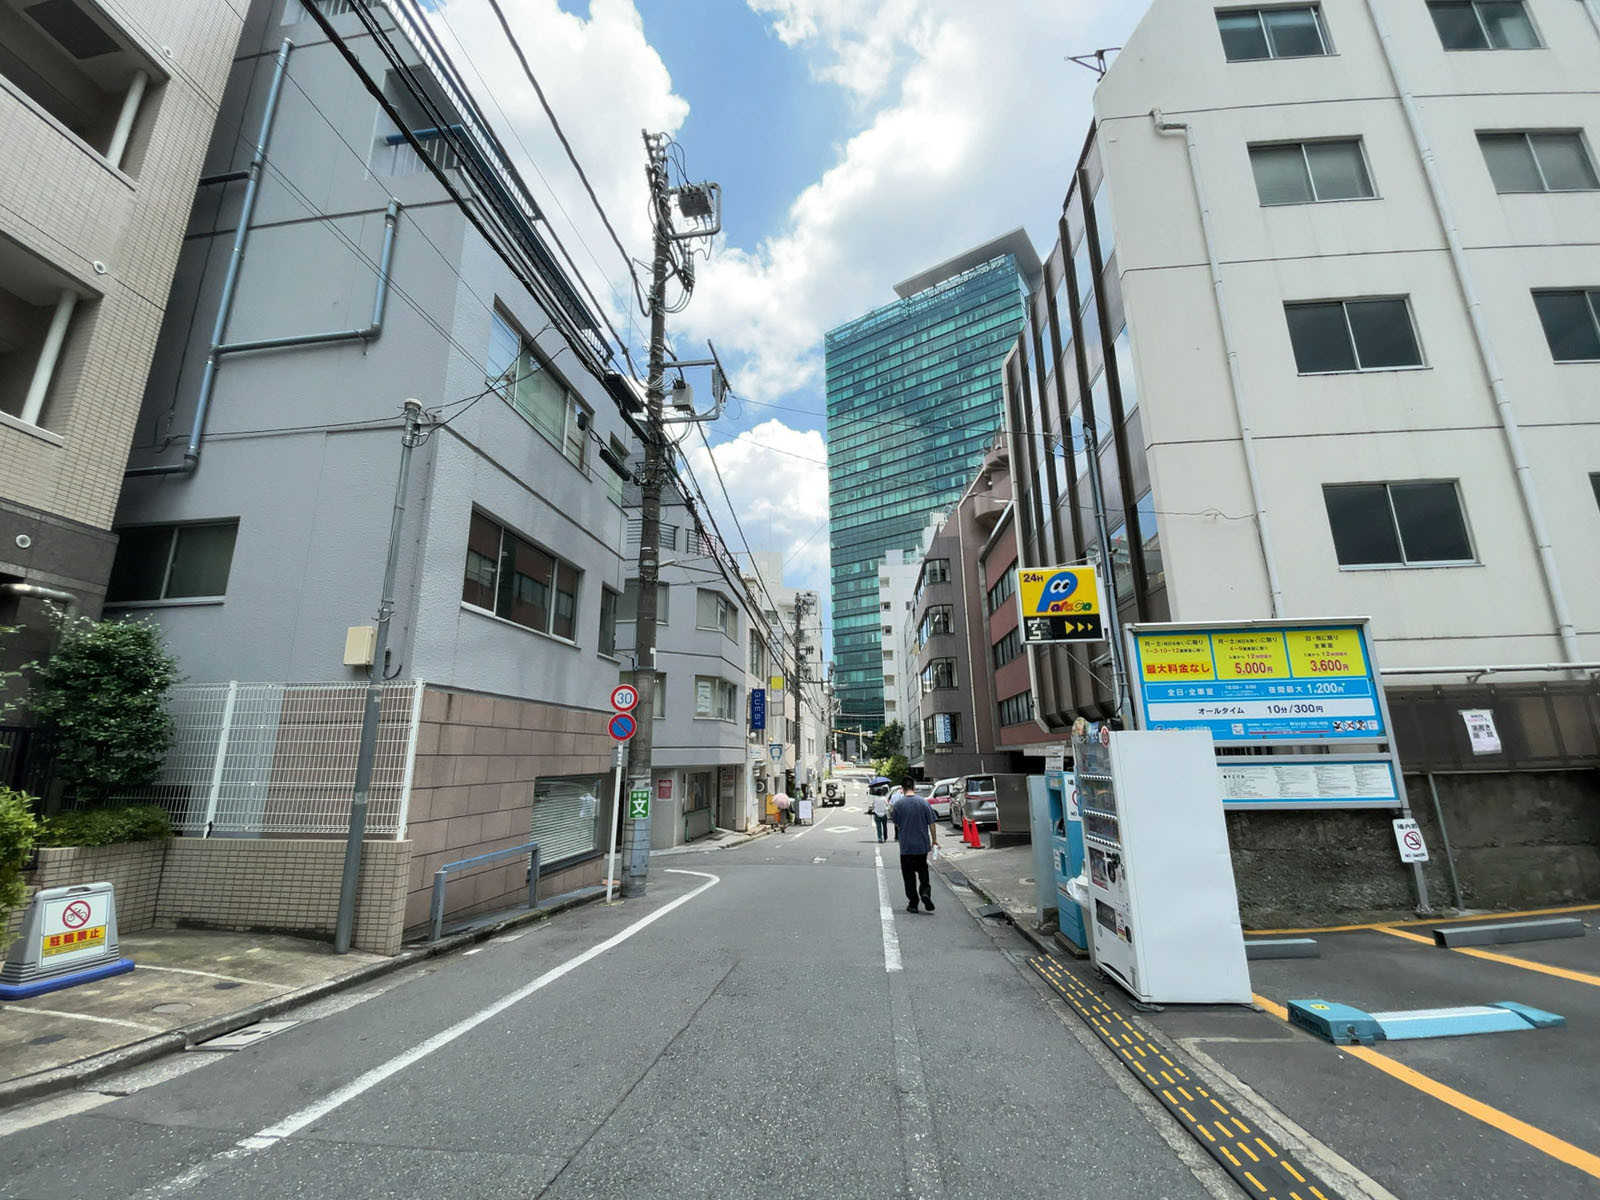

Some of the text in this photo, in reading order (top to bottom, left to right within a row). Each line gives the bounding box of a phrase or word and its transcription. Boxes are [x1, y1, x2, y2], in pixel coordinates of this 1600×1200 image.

[1023, 573, 1044, 583] 24H
[1146, 664, 1210, 674] 最大料金なし
[1234, 662, 1273, 674] 5,000円
[1310, 659, 1349, 672] 3,600円
[616, 692, 633, 705] 30
[1198, 706, 1245, 715] オールタイム
[631, 798, 647, 815] 文
